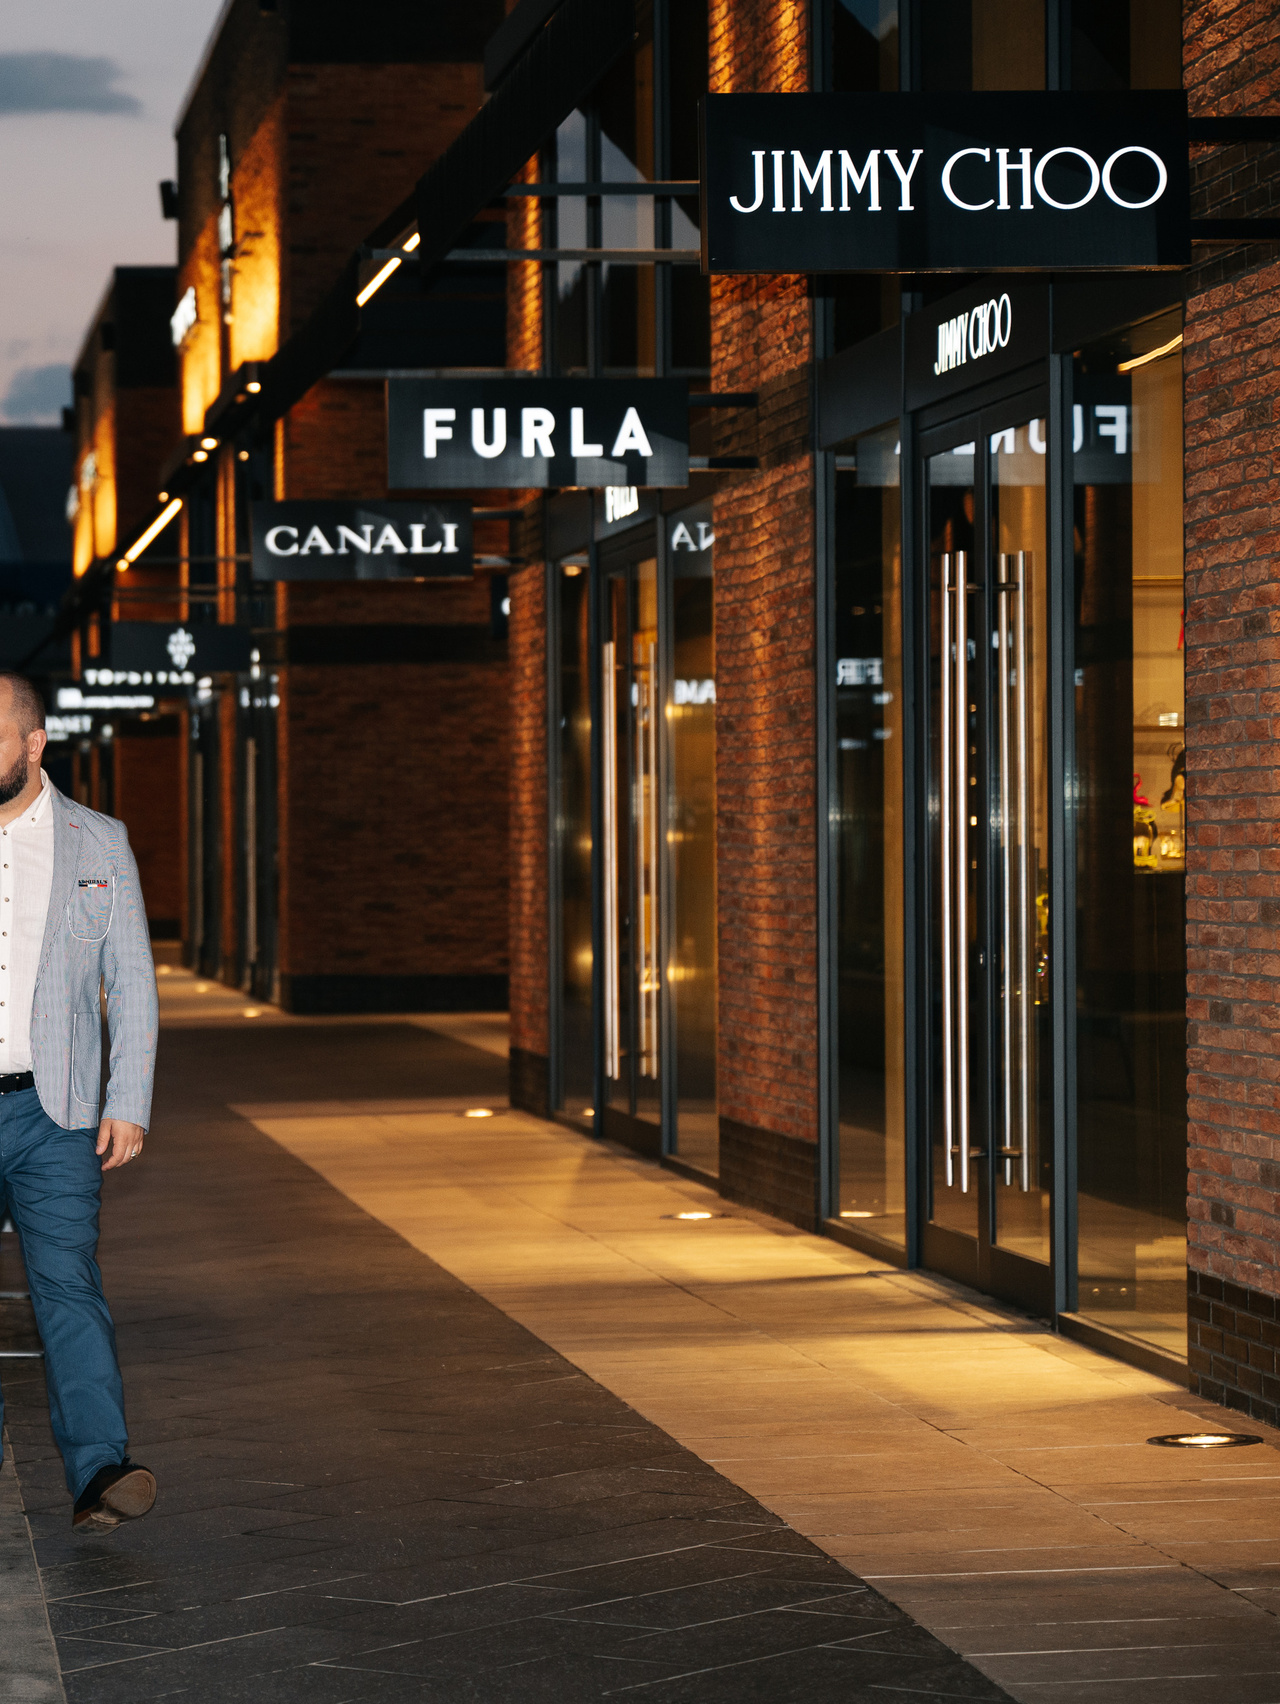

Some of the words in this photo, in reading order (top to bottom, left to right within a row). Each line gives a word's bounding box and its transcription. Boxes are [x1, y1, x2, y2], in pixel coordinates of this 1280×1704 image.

[729, 149, 923, 213] JIMMY
[941, 146, 1167, 211] CHOO
[934, 312, 969, 376] JIMMY
[969, 293, 1011, 359] CHOO
[423, 407, 653, 459] FURLA
[264, 523, 459, 556] CANALI
